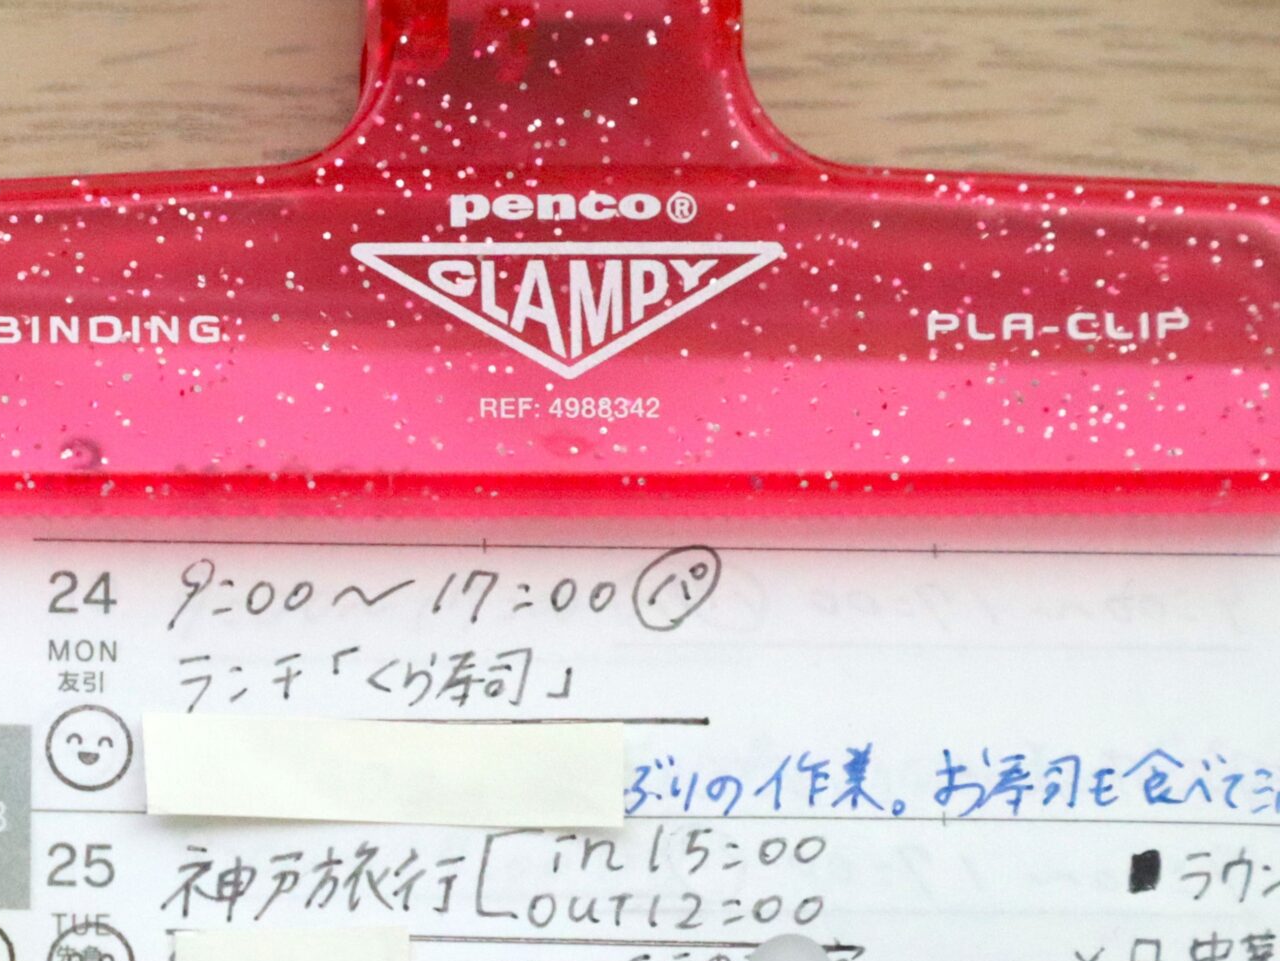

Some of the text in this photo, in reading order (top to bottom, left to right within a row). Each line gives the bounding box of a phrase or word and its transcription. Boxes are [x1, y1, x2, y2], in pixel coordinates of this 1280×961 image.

[429, 257, 719, 359] GLAMPY
[927, 311, 1191, 342] PLA-CLIP
[479, 397, 662, 419] REF: 4988342
[48, 570, 118, 615] 24
[47, 639, 119, 663] MON
[57, 671, 106, 694] 友引
[46, 842, 116, 888] 25
[51, 912, 112, 936] TUE
